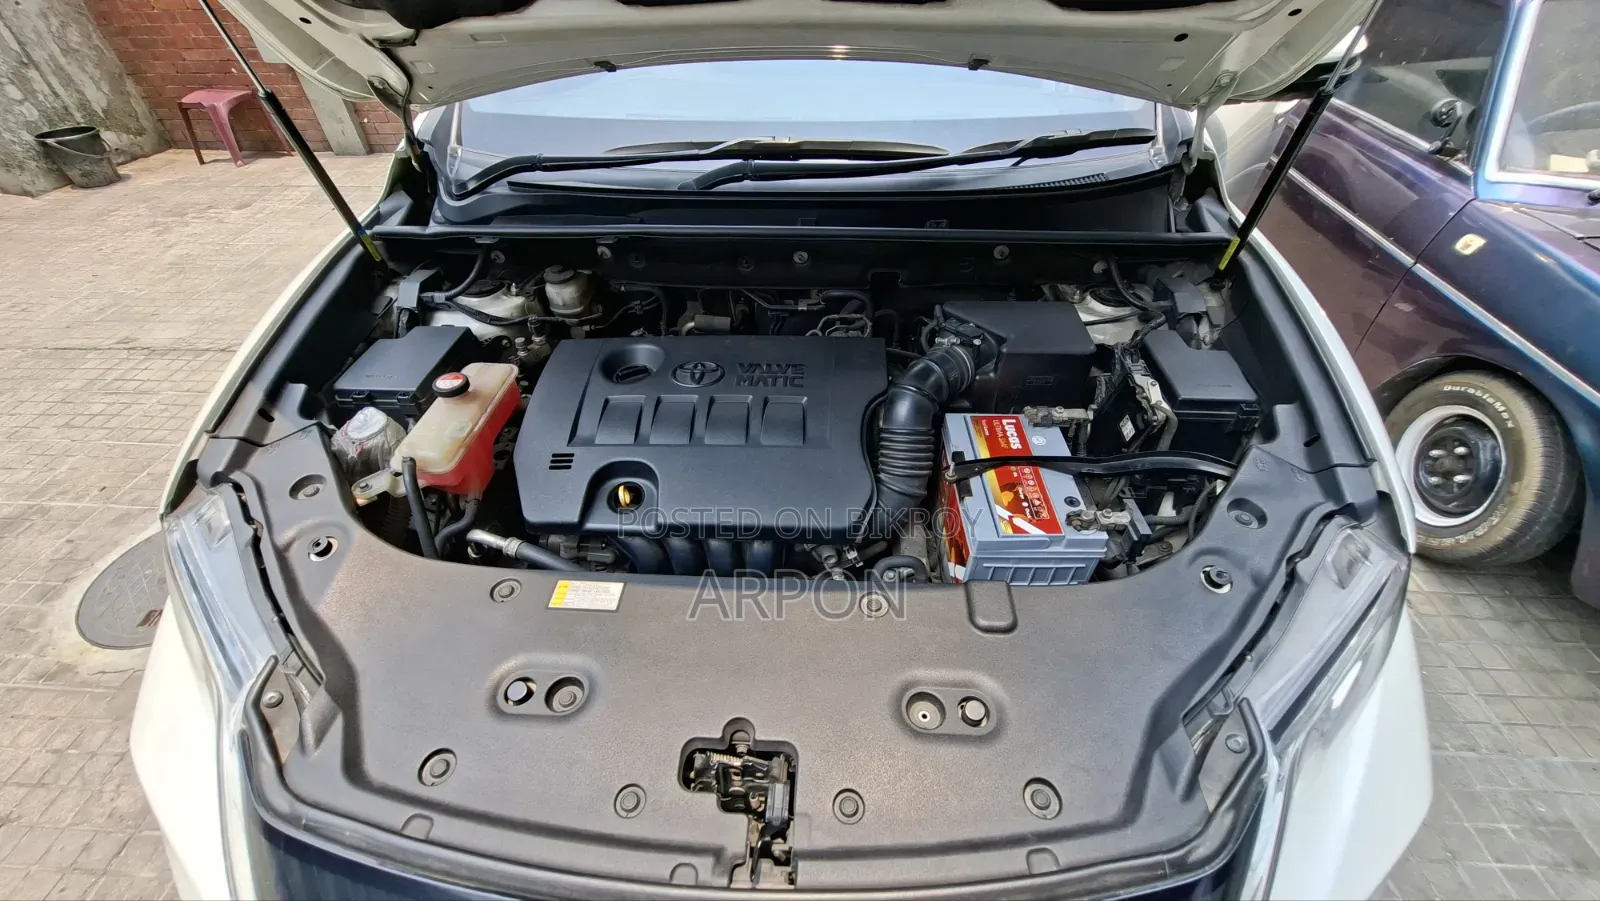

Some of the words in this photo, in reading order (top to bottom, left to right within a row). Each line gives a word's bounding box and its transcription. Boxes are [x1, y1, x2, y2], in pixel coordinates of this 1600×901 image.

[736, 362, 805, 375] VALVE
[735, 375, 804, 388] MATIC
[1001, 419, 1022, 450] Lucas
